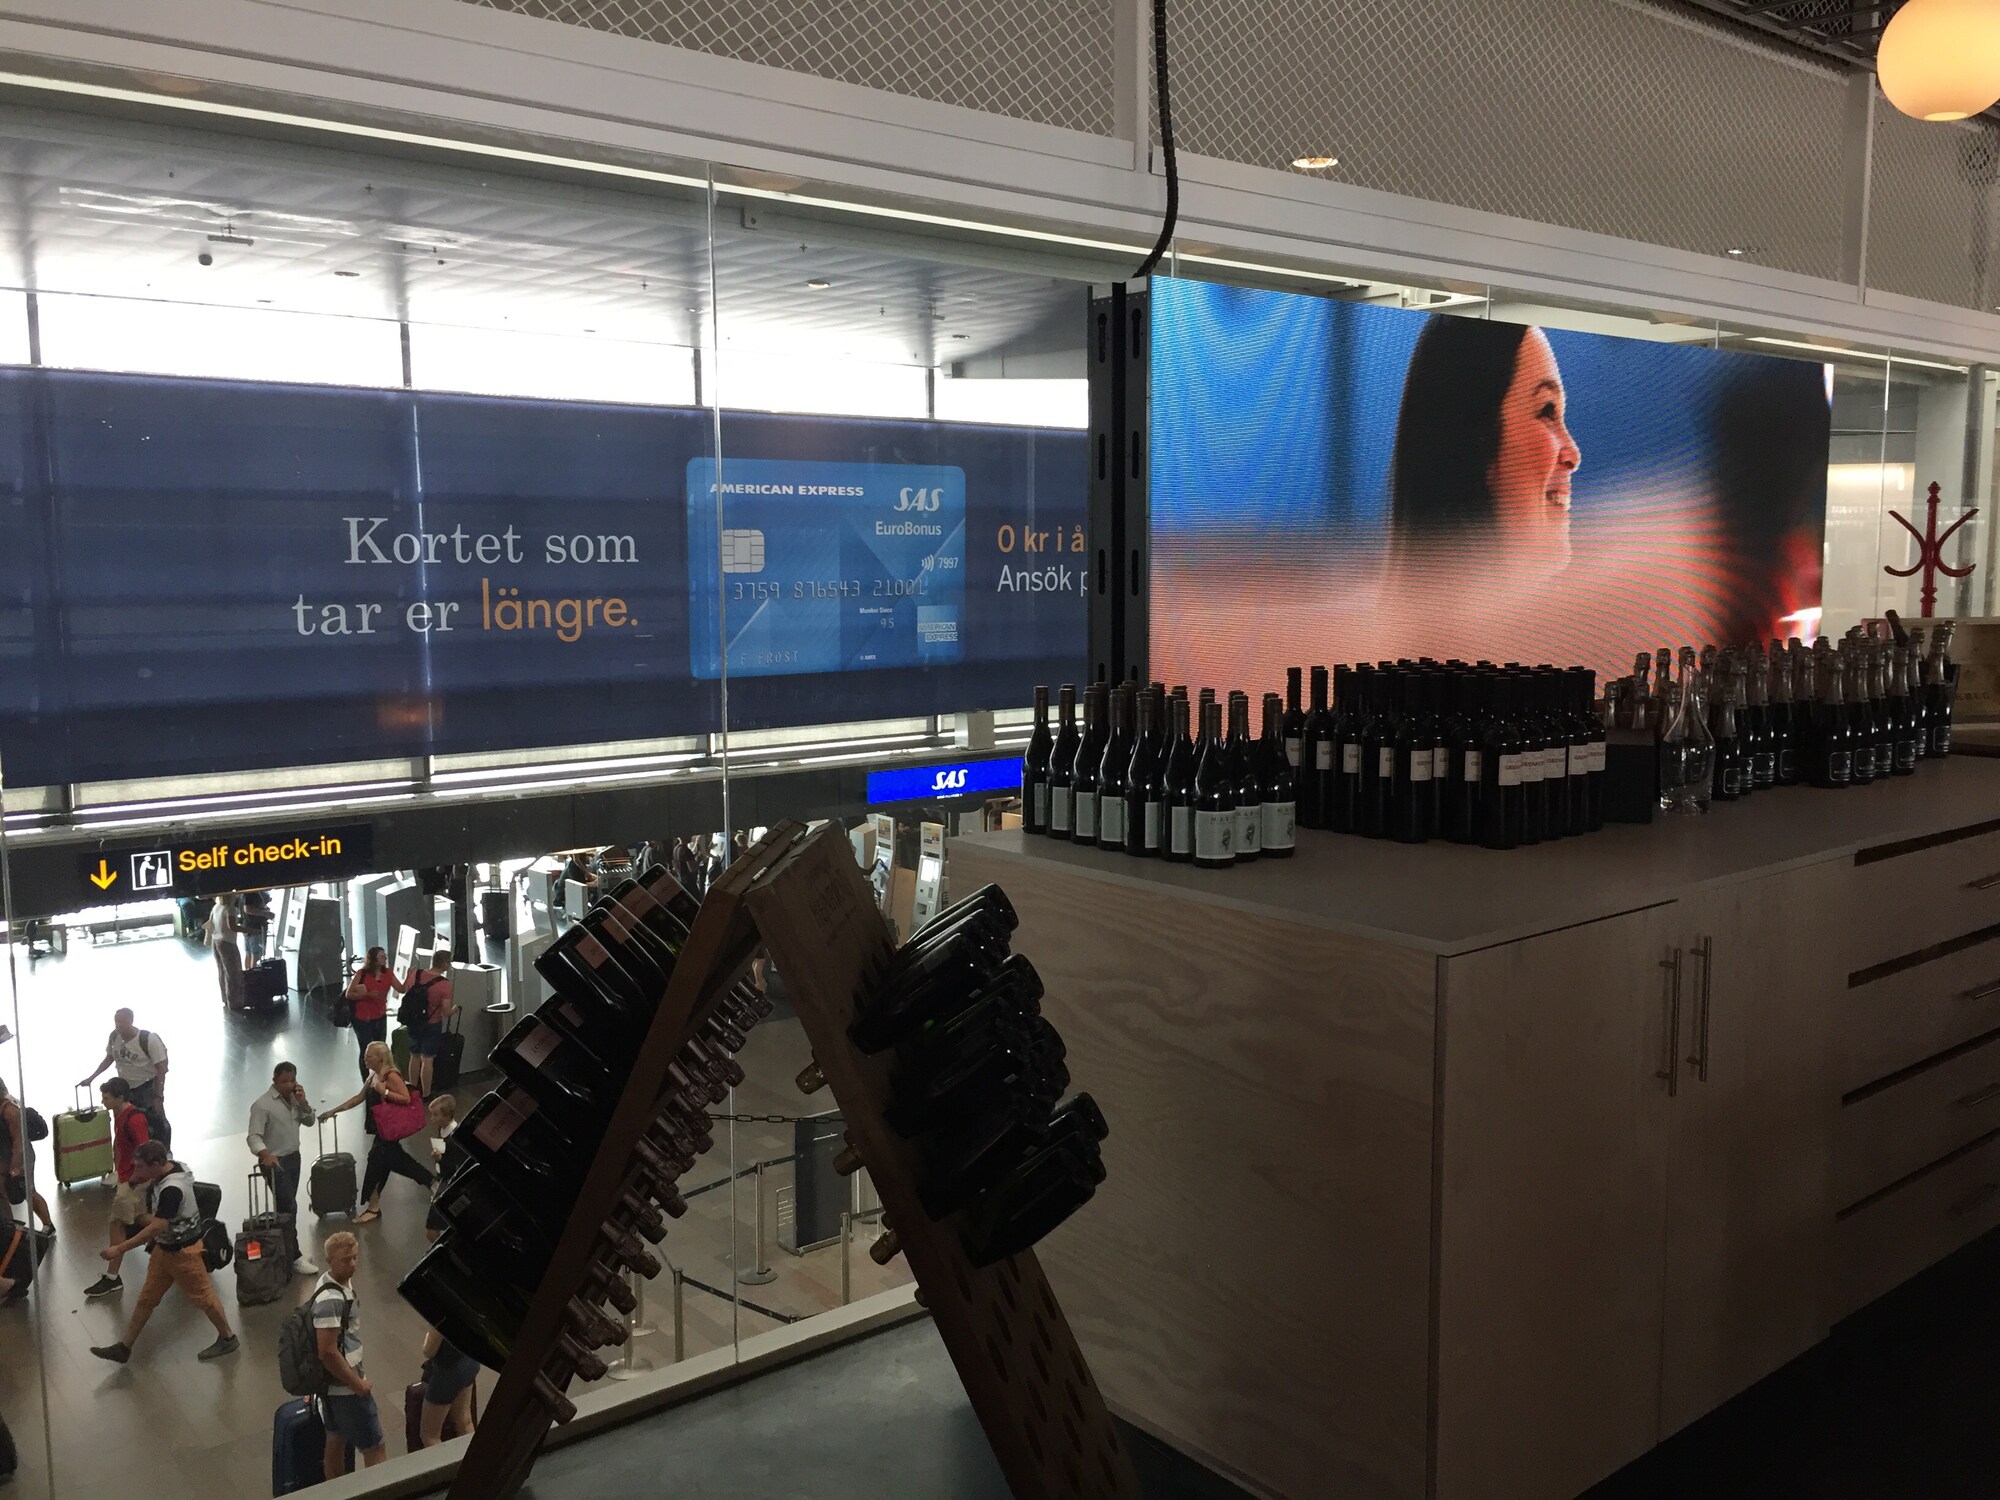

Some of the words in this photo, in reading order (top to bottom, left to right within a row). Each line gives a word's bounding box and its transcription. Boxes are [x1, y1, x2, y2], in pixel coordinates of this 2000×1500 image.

[710, 483, 793, 495] AMERICAN
[798, 485, 864, 497] EXPRESS
[893, 487, 944, 512] SAS
[875, 521, 942, 536] EuroBonus
[1024, 525, 1049, 552] kr
[1057, 525, 1063, 552] i
[342, 517, 524, 564] Kortet
[545, 532, 640, 563] som
[938, 557, 959, 569] 7997
[733, 582, 780, 600] 3759
[794, 580, 861, 598] 876543
[873, 579, 925, 597] 21001
[997, 564, 1072, 592] Ansök
[292, 593, 382, 636] tar
[406, 601, 459, 633] er
[482, 577, 639, 643] längre.
[880, 617, 895, 629] 95
[931, 769, 969, 791] SAS
[179, 845, 229, 872] Self
[233, 835, 342, 865] check-in
